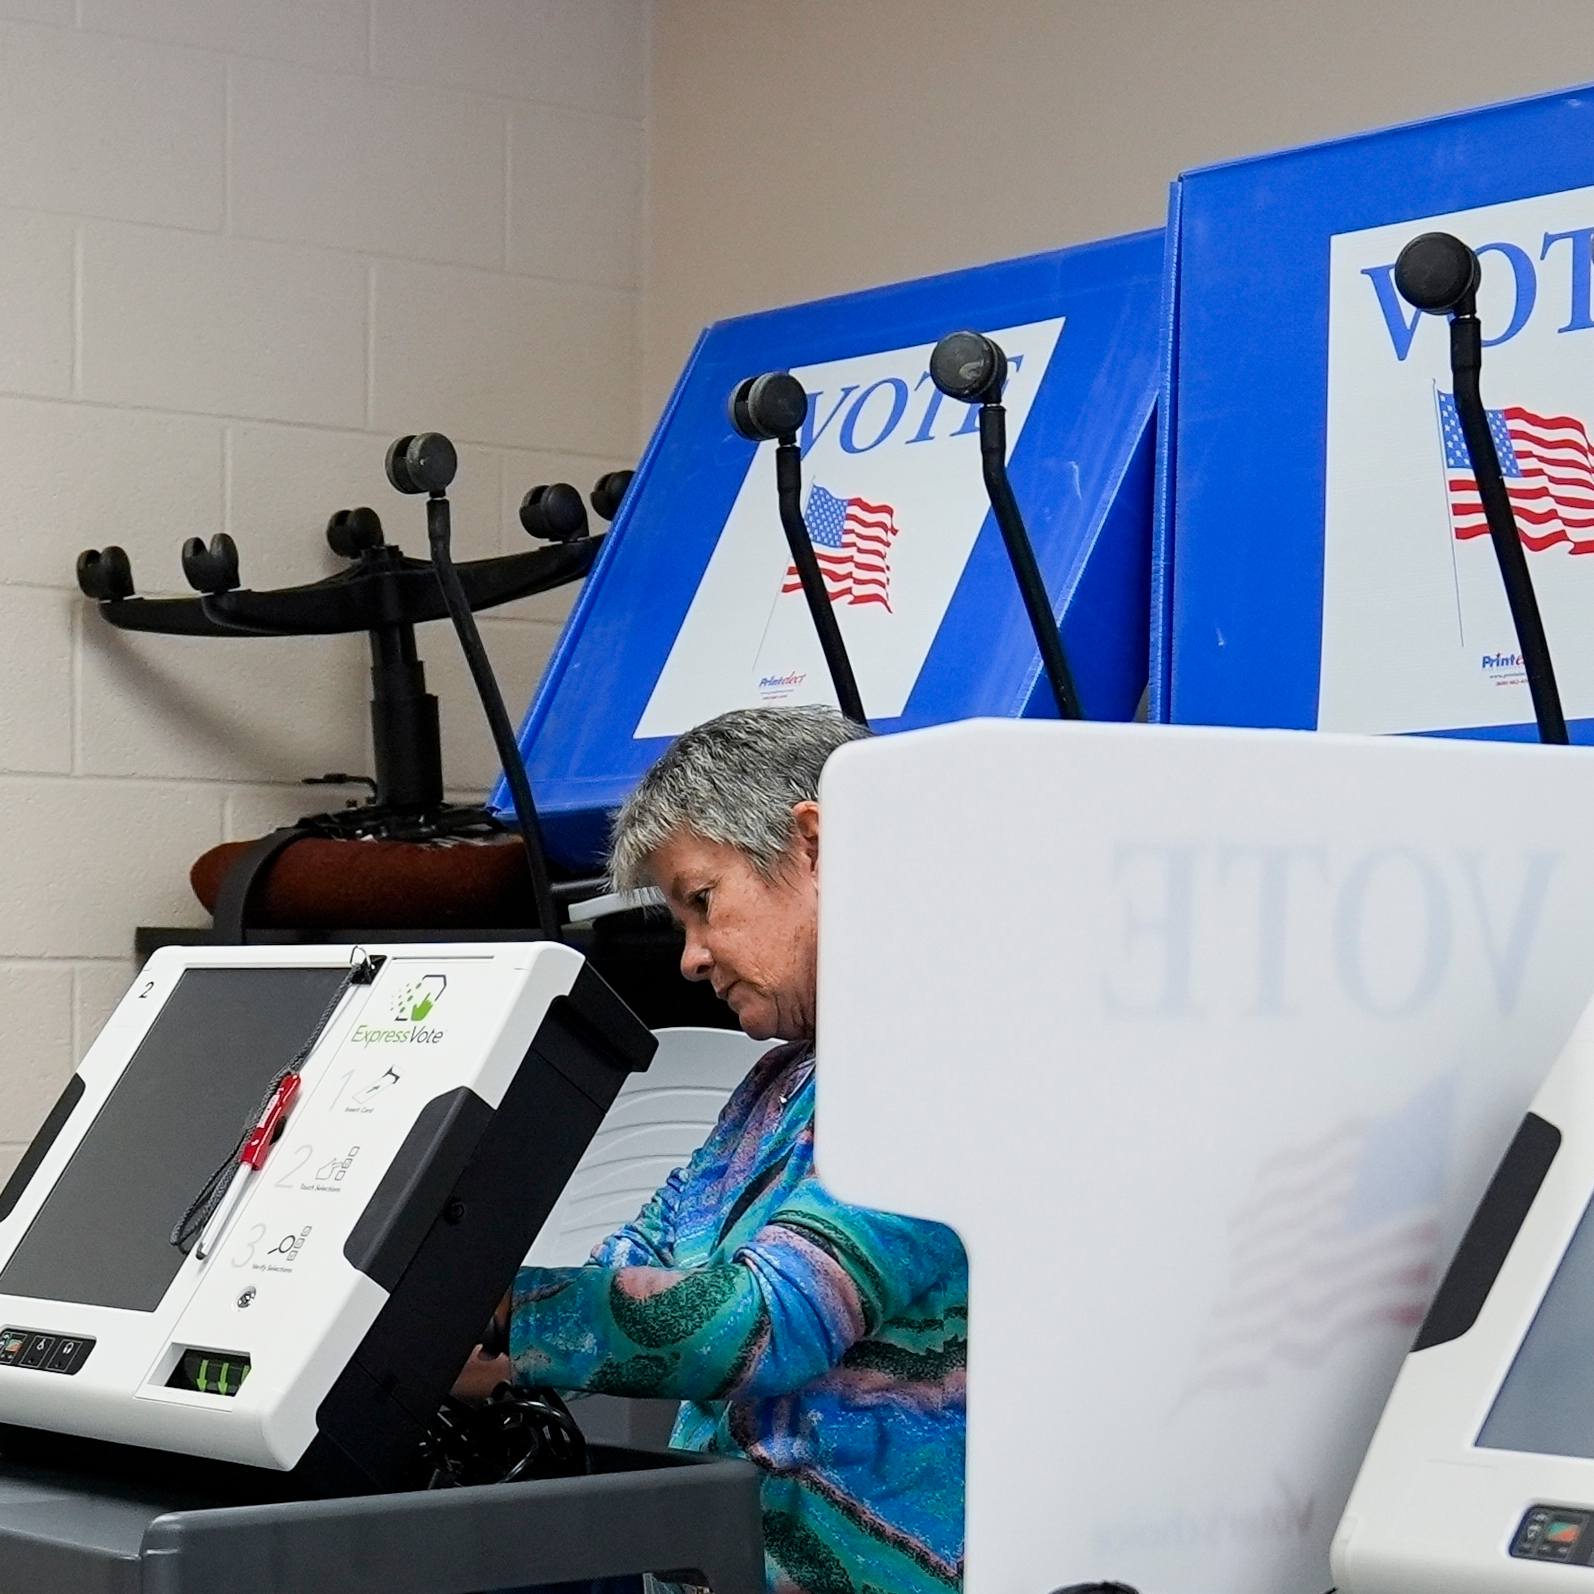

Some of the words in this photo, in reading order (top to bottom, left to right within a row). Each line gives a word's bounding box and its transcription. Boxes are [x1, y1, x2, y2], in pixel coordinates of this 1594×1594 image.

[138, 981, 155, 999] 2
[351, 1024, 445, 1050] ExpressVote
[274, 1144, 314, 1189] 2
[231, 1223, 267, 1268] 3
